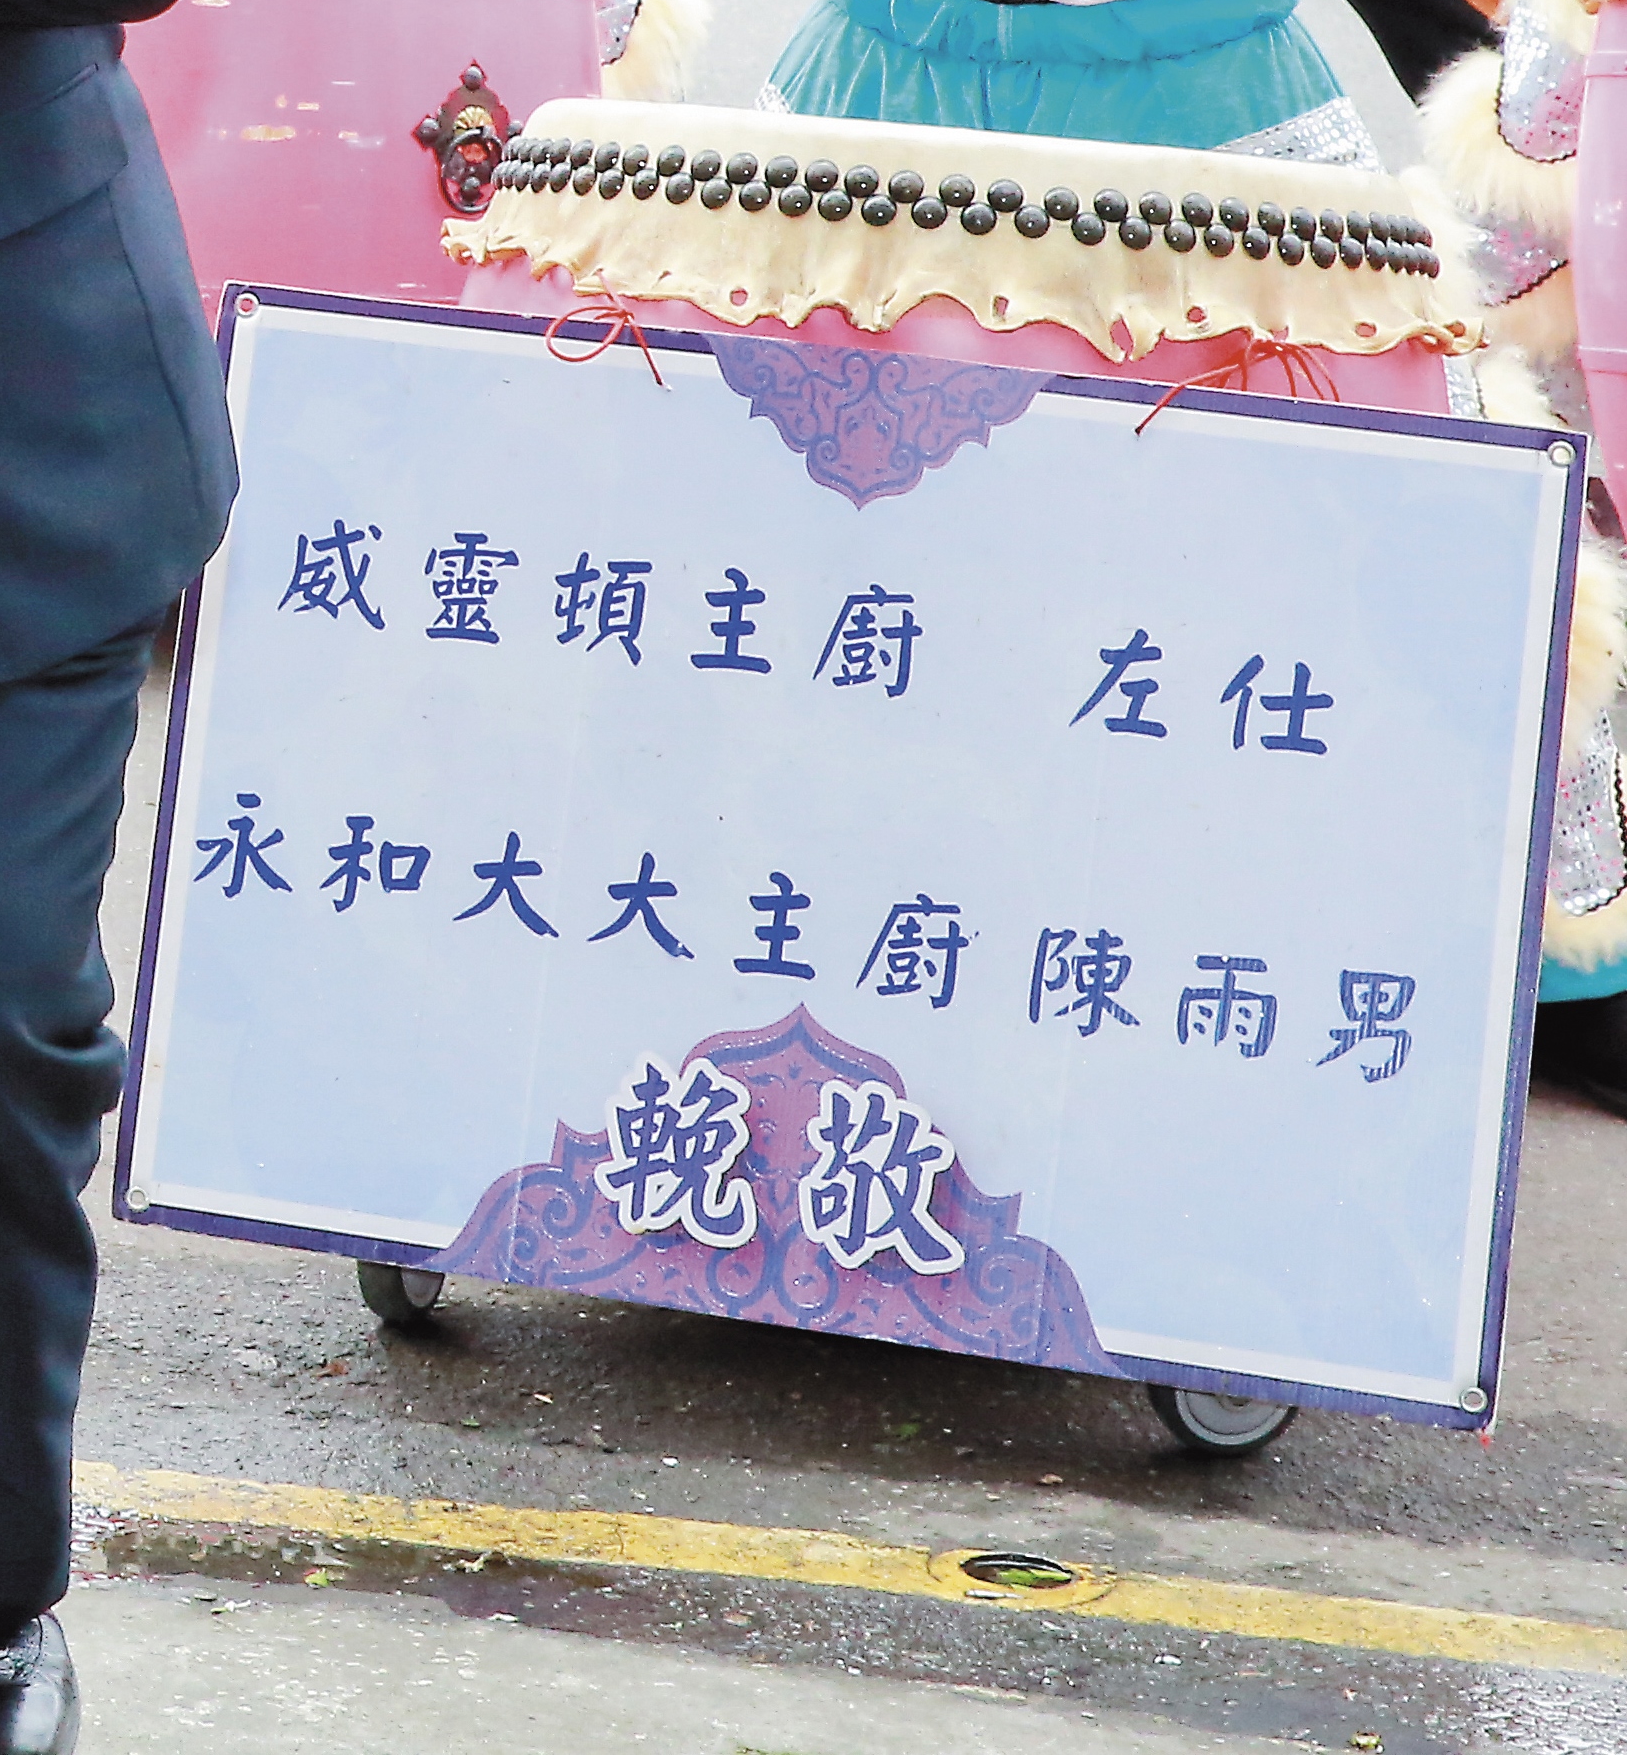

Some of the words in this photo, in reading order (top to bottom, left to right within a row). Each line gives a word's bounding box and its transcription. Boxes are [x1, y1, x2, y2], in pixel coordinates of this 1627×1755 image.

[277, 519, 923, 698] 威靈頓主廚
[1069, 628, 1334, 756] 左仕
[606, 1062, 953, 1262] 輓敬
